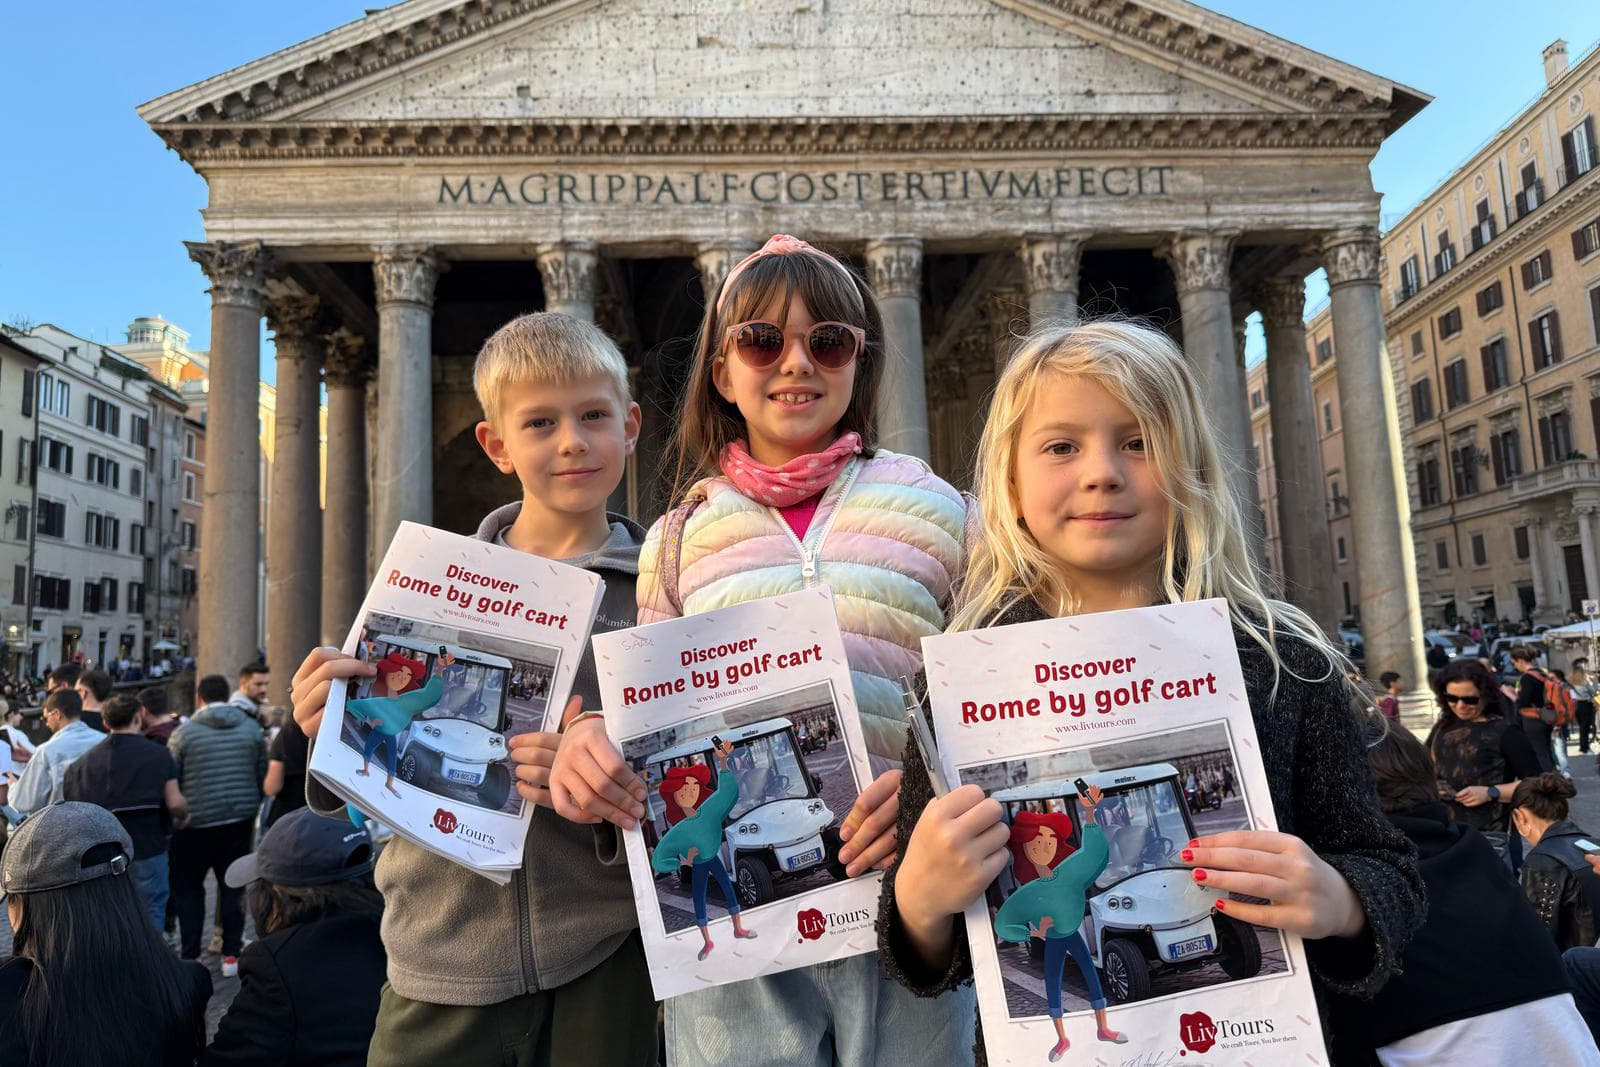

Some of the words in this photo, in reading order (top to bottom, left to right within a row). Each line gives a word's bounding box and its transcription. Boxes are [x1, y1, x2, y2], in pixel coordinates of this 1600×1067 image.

[446, 564, 520, 594] Discover
[387, 569, 443, 597] Rome
[446, 584, 473, 609] by
[477, 595, 525, 617] golf
[524, 607, 569, 631] cart
[443, 608, 500, 628] www.livtours.com
[596, 613, 634, 627] olumbia
[680, 637, 758, 667] Discover
[623, 676, 686, 706] Rome
[691, 669, 720, 689] by
[725, 653, 772, 685] golf
[776, 643, 823, 669] cart
[1035, 656, 1137, 684] Discover
[696, 684, 759, 703] www.livtours.com
[961, 697, 1041, 725] Rome
[1049, 690, 1087, 718] by
[1094, 678, 1155, 715] golf
[1160, 672, 1217, 700] cart
[1055, 716, 1137, 734] www.livtours.com
[437, 815, 496, 845] LivTours
[803, 908, 870, 934] LivTours
[1186, 1018, 1274, 1044] LivTours
